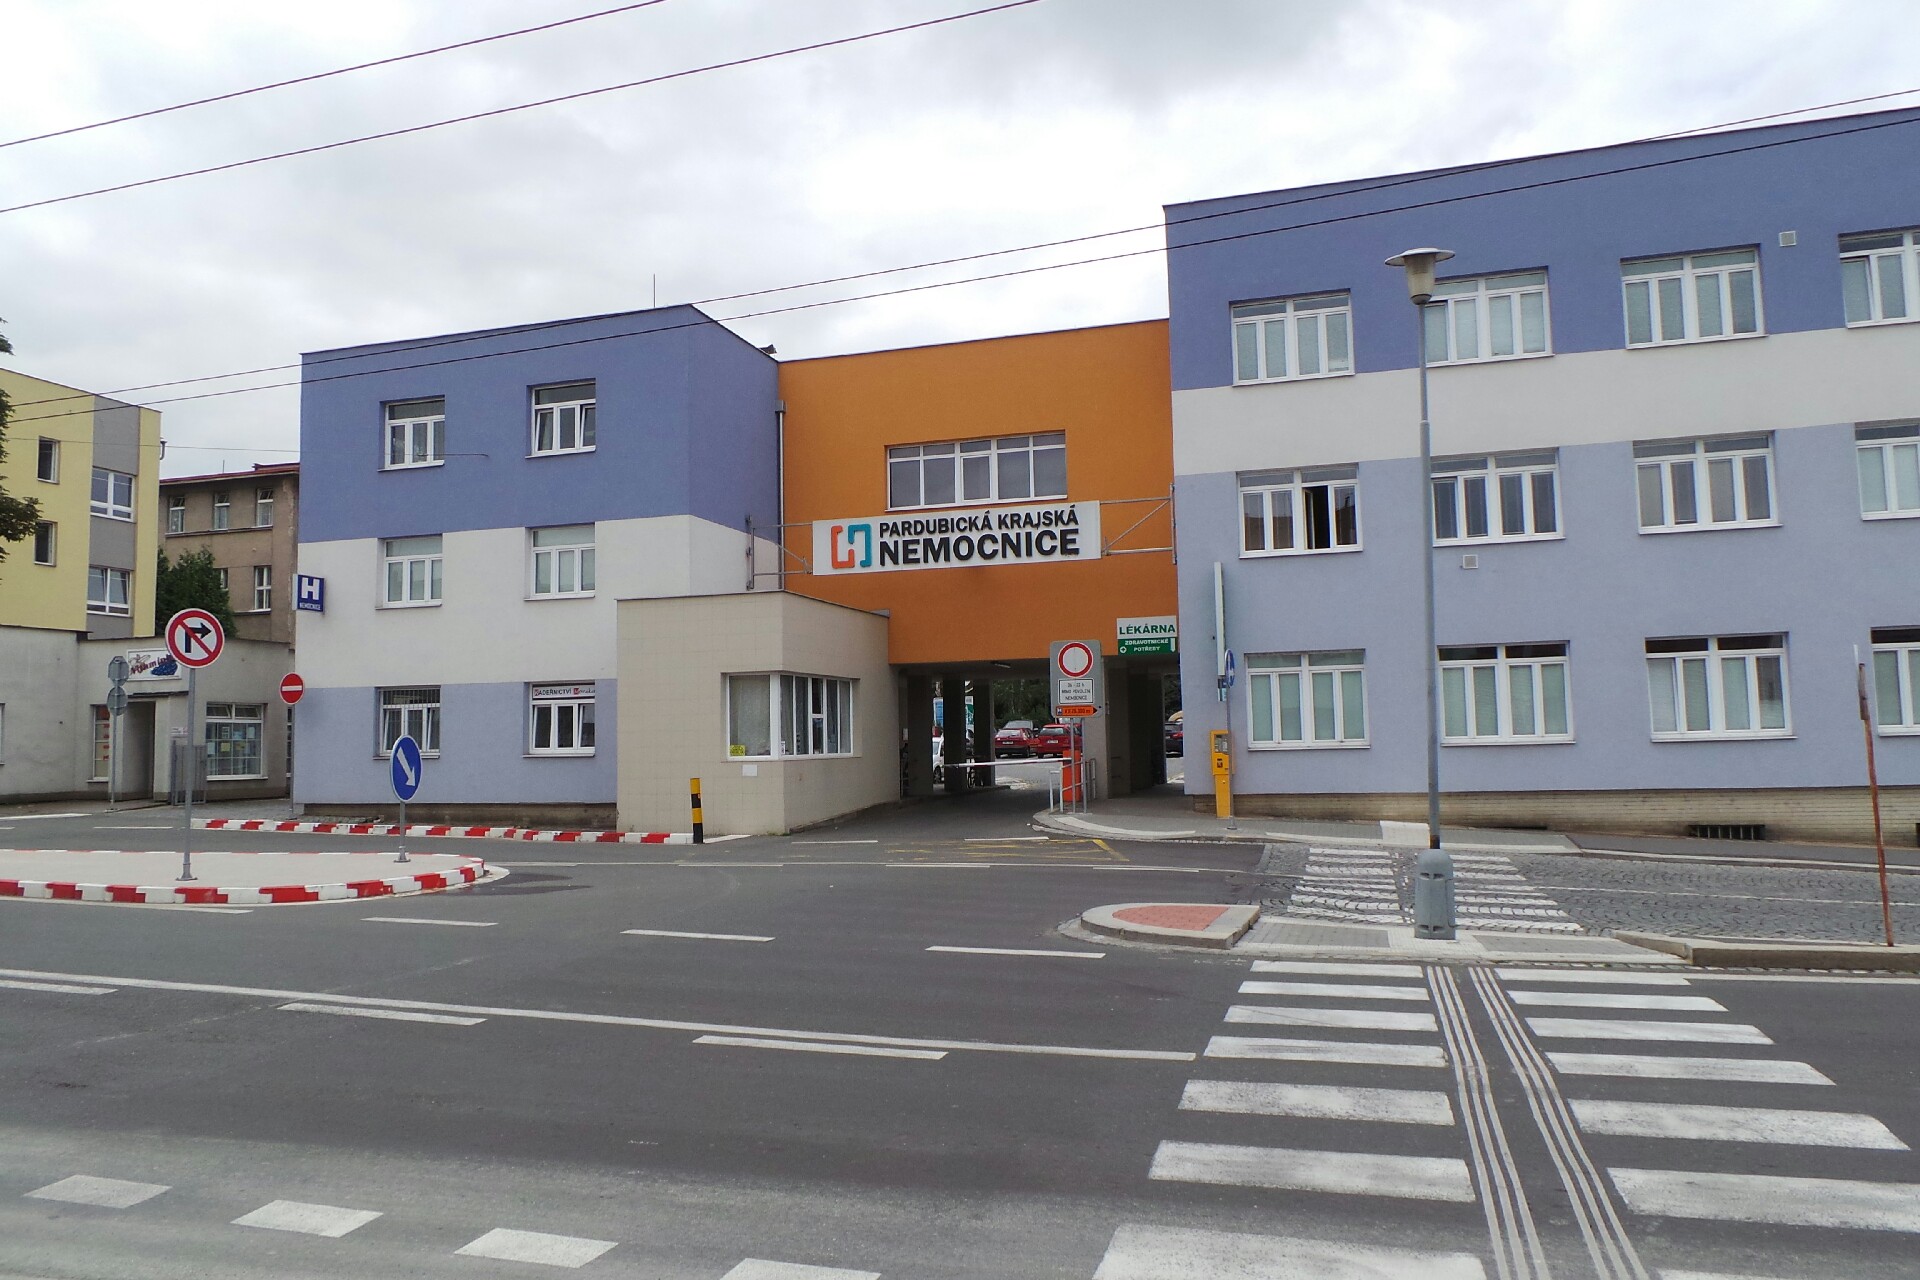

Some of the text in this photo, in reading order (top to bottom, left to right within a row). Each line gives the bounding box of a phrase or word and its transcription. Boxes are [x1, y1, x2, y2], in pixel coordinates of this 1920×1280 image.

[879, 504, 1079, 538] PARDUBICKÁ KRAJSKÁ
[879, 528, 1080, 566] NEMOCNICE
[301, 577, 320, 600] H
[1119, 623, 1176, 635] LÉKÁRNA
[1125, 638, 1169, 646] ZDRAVOTNICKÉ
[534, 687, 572, 697] KADEŘNICTVÍ
